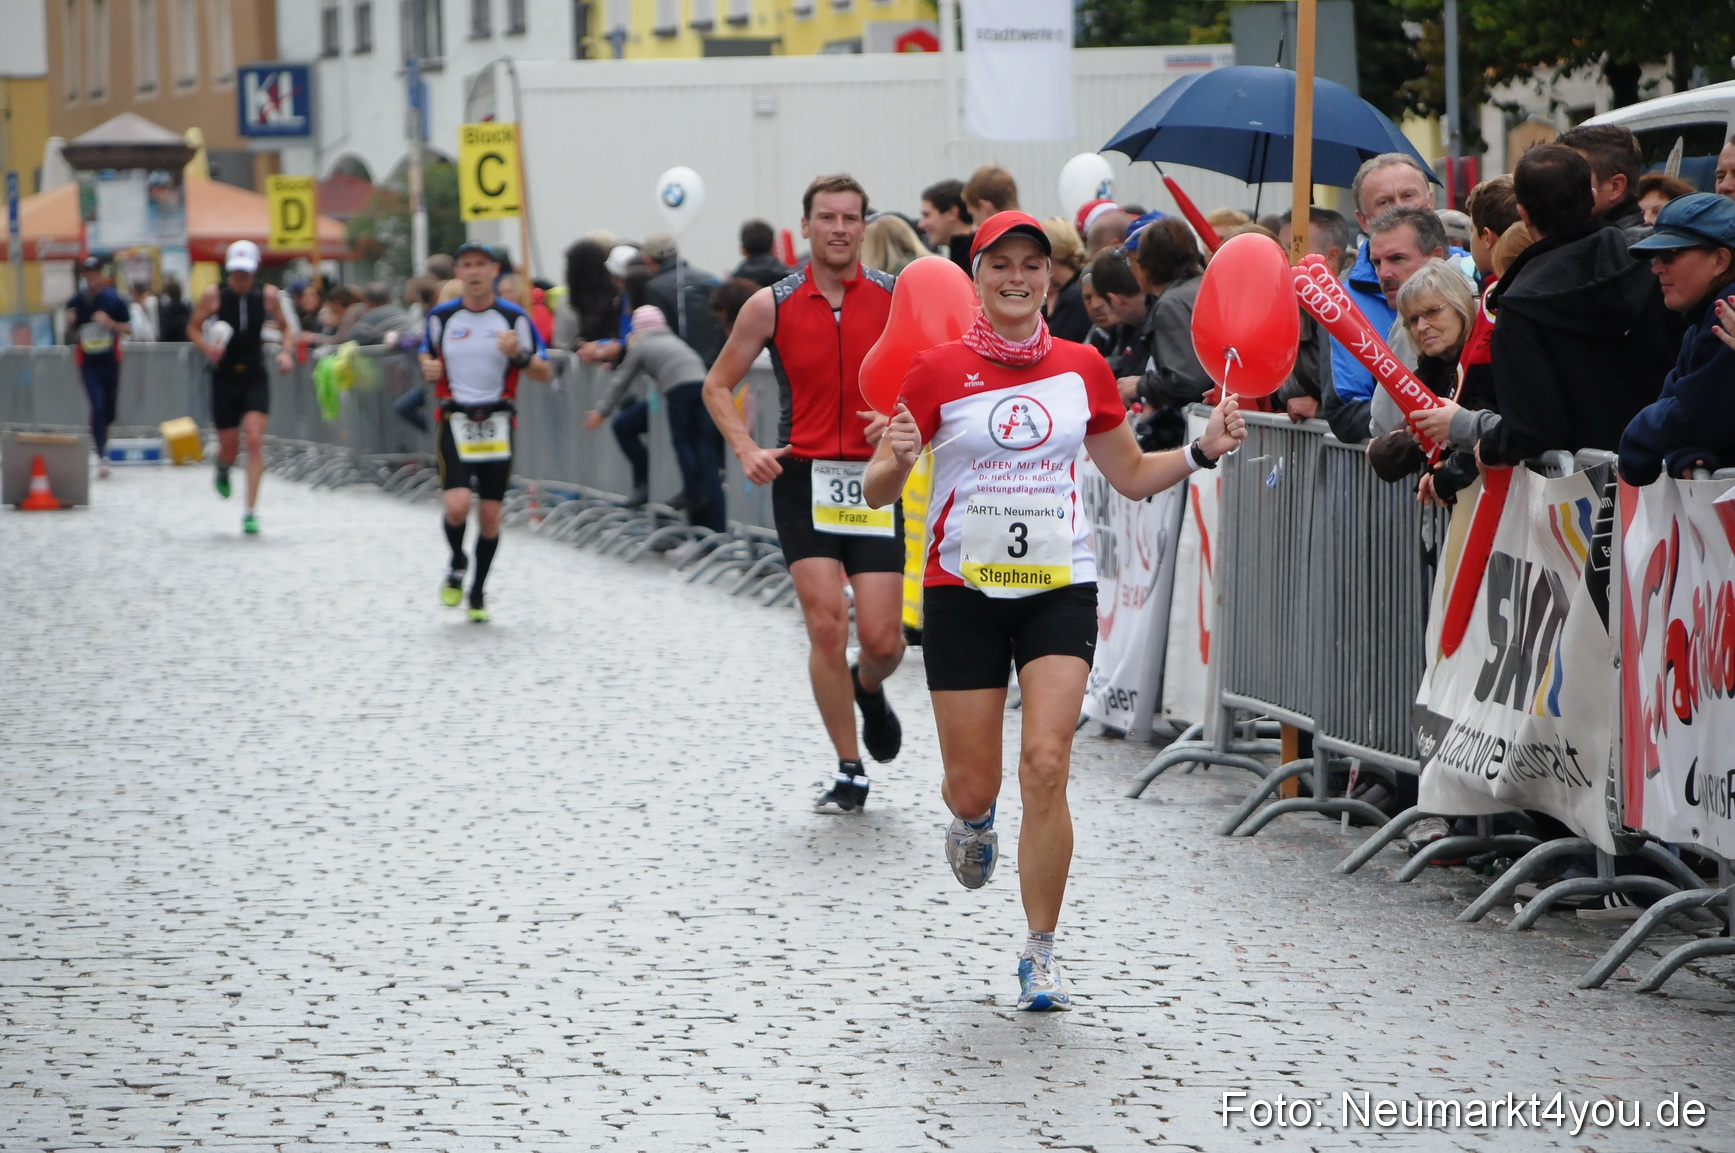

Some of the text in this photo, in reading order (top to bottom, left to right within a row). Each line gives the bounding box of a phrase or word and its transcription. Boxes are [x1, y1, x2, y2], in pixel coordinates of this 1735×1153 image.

[476, 152, 507, 197] C
[281, 198, 306, 232] D
[1350, 330, 1440, 411] udi BKK
[964, 380, 985, 388] erima
[992, 473, 1012, 481] Heck
[830, 479, 862, 505] 39
[976, 484, 1056, 495] Leistungsdiagnostik
[838, 510, 868, 523] Franz
[966, 505, 1055, 517] PARTL Neumarkt
[1007, 521, 1029, 559] 3
[979, 567, 1052, 587] Stephanie
